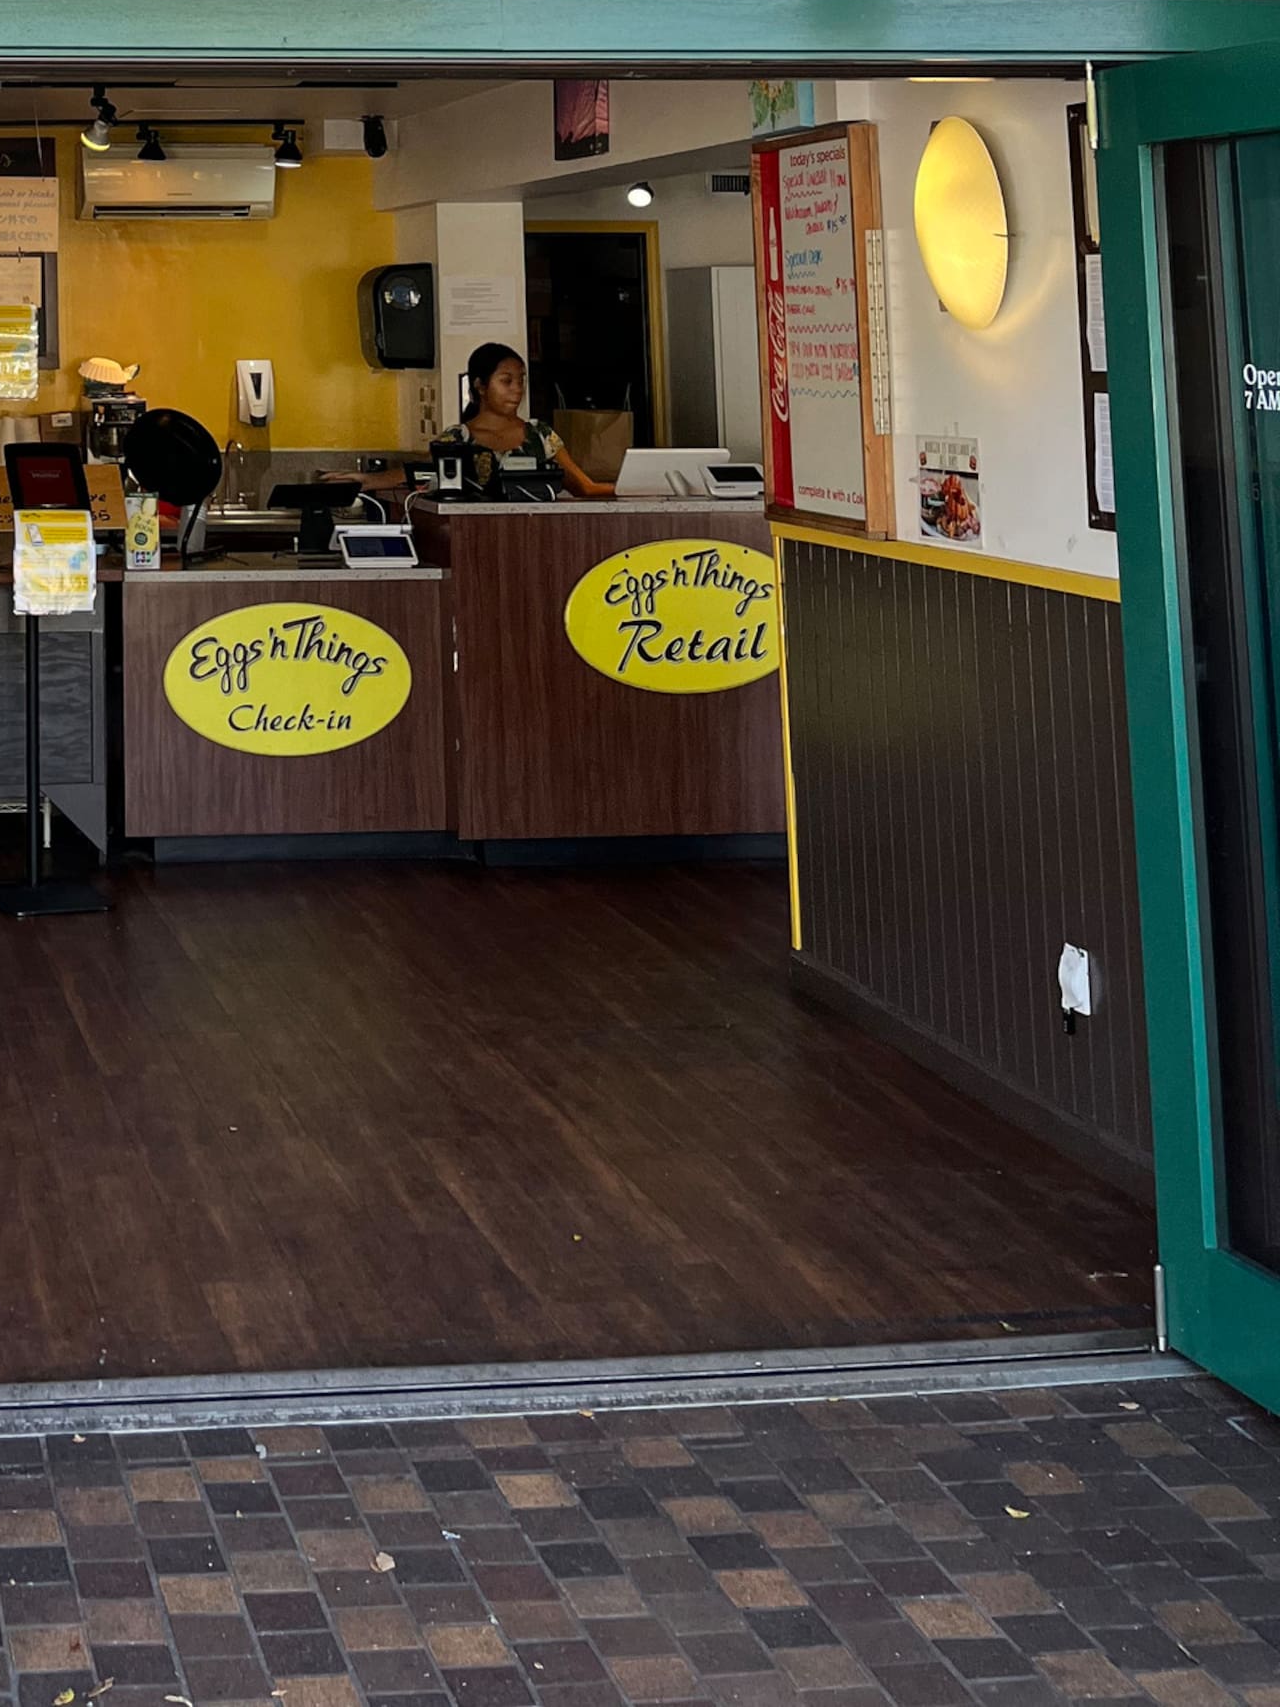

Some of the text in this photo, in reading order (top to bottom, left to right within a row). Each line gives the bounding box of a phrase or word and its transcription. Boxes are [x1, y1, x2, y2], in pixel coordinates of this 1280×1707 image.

[816, 145, 845, 165] specials
[1244, 390, 1253, 409] 7
[605, 568, 667, 616] Eggs
[683, 548, 775, 617] Things
[189, 635, 265, 695] Eggs
[282, 614, 389, 697] Things
[617, 619, 768, 674] Retail
[227, 703, 353, 732] Check-in
